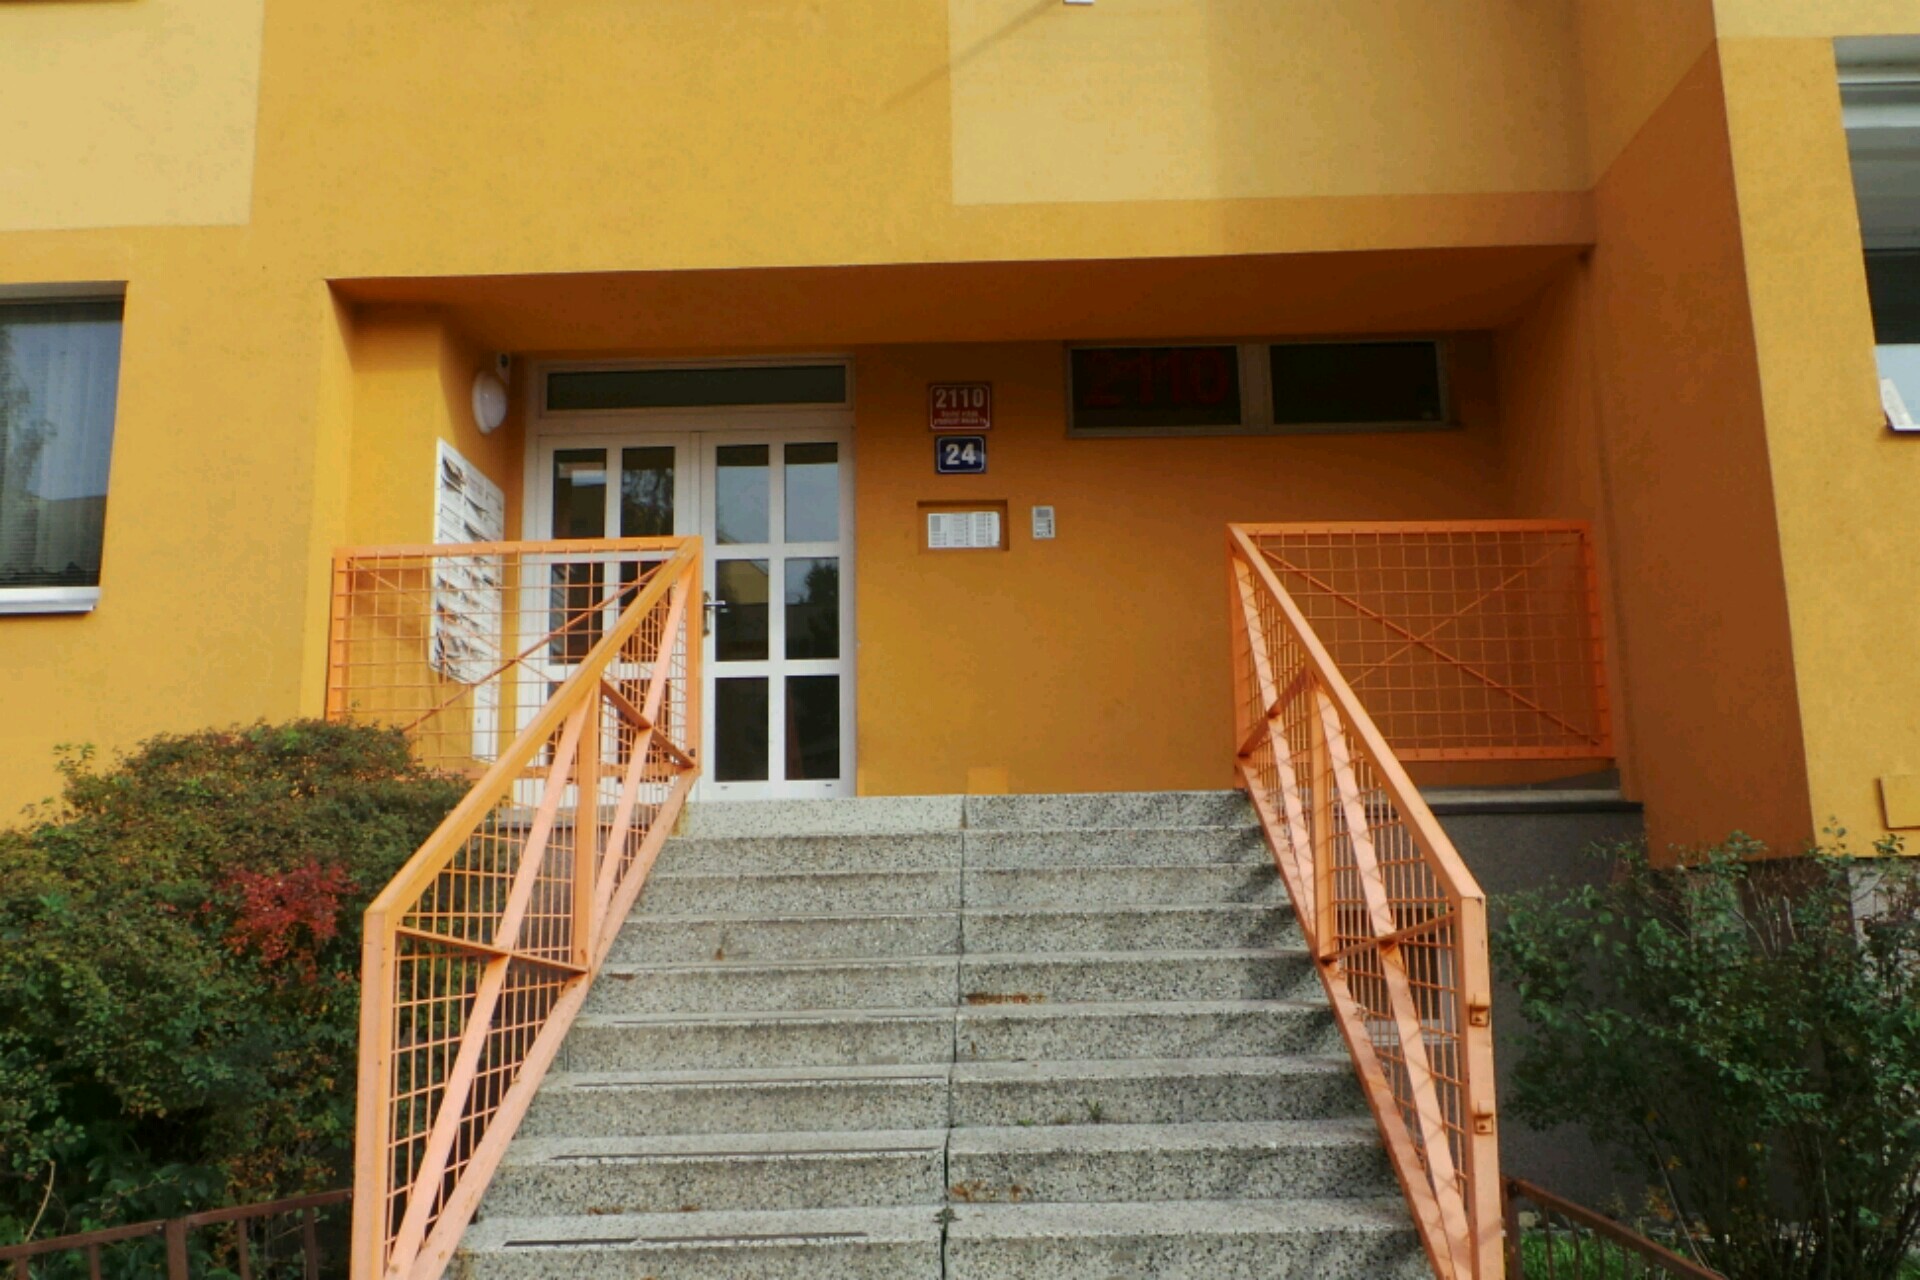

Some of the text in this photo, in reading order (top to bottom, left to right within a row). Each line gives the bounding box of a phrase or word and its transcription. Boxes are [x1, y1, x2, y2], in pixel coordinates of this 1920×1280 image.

[1084, 350, 1229, 405] 2110
[935, 389, 984, 408] 2110
[945, 443, 977, 465] 24
